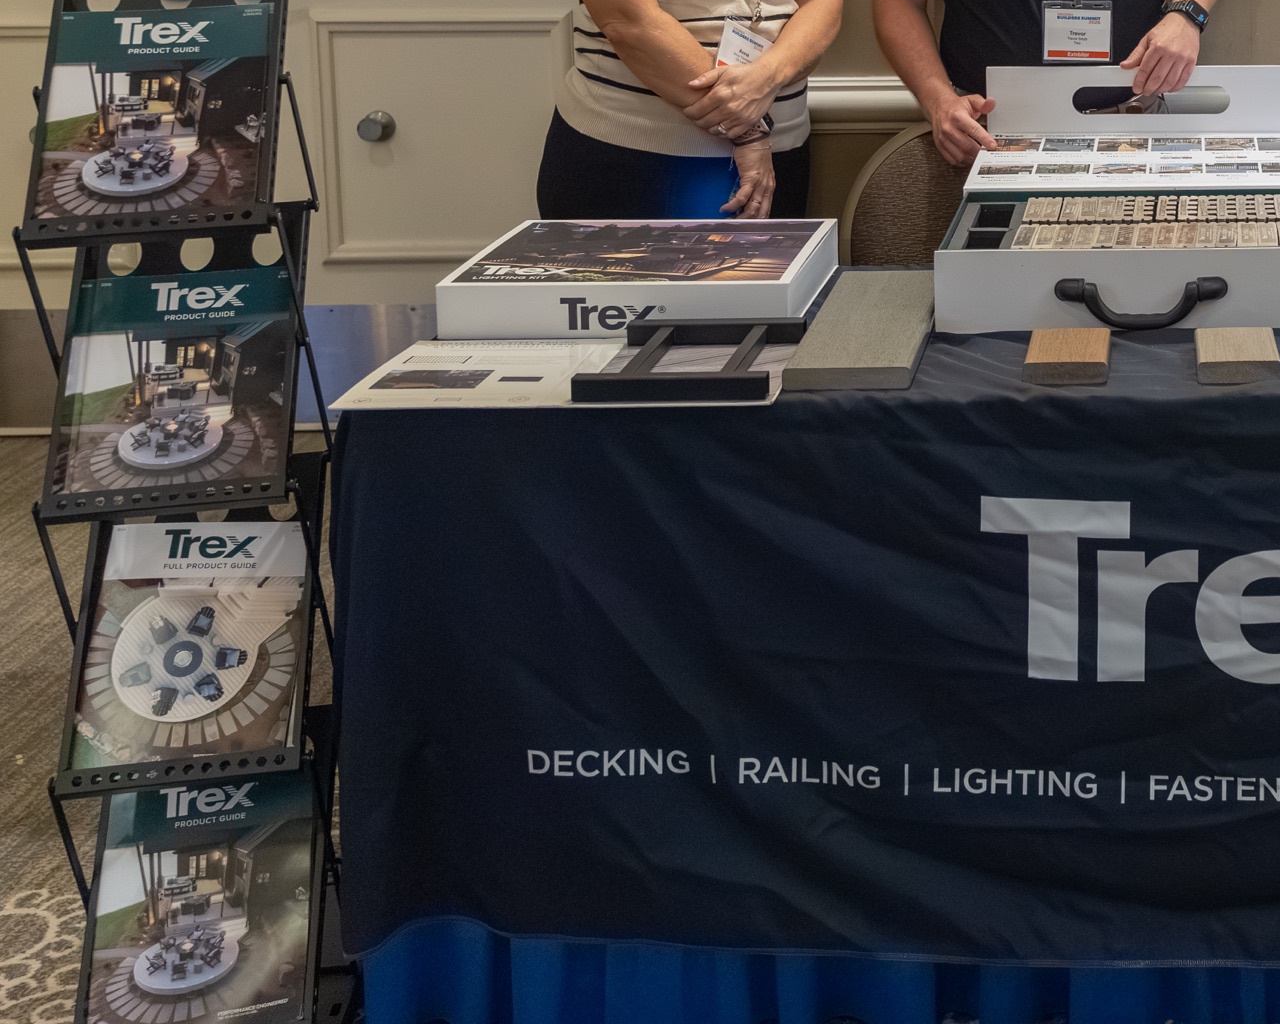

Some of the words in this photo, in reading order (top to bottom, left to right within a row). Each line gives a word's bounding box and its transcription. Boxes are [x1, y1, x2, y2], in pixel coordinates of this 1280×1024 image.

[114, 16, 210, 45] Trex
[127, 47, 170, 55] PRODUCT
[173, 46, 200, 54] GUIDE
[151, 282, 245, 312] Trex
[164, 312, 206, 321] PRODUCT
[209, 310, 235, 319] GUIDE
[165, 529, 256, 559] Trex
[186, 562, 228, 570] PRODUCT
[527, 749, 690, 777] DECKING
[738, 756, 881, 789] RAILING
[933, 767, 1098, 799] LIGHTING
[160, 782, 254, 819] Trex
[175, 816, 216, 829] PRODUCT
[219, 812, 246, 822] GUIDE
